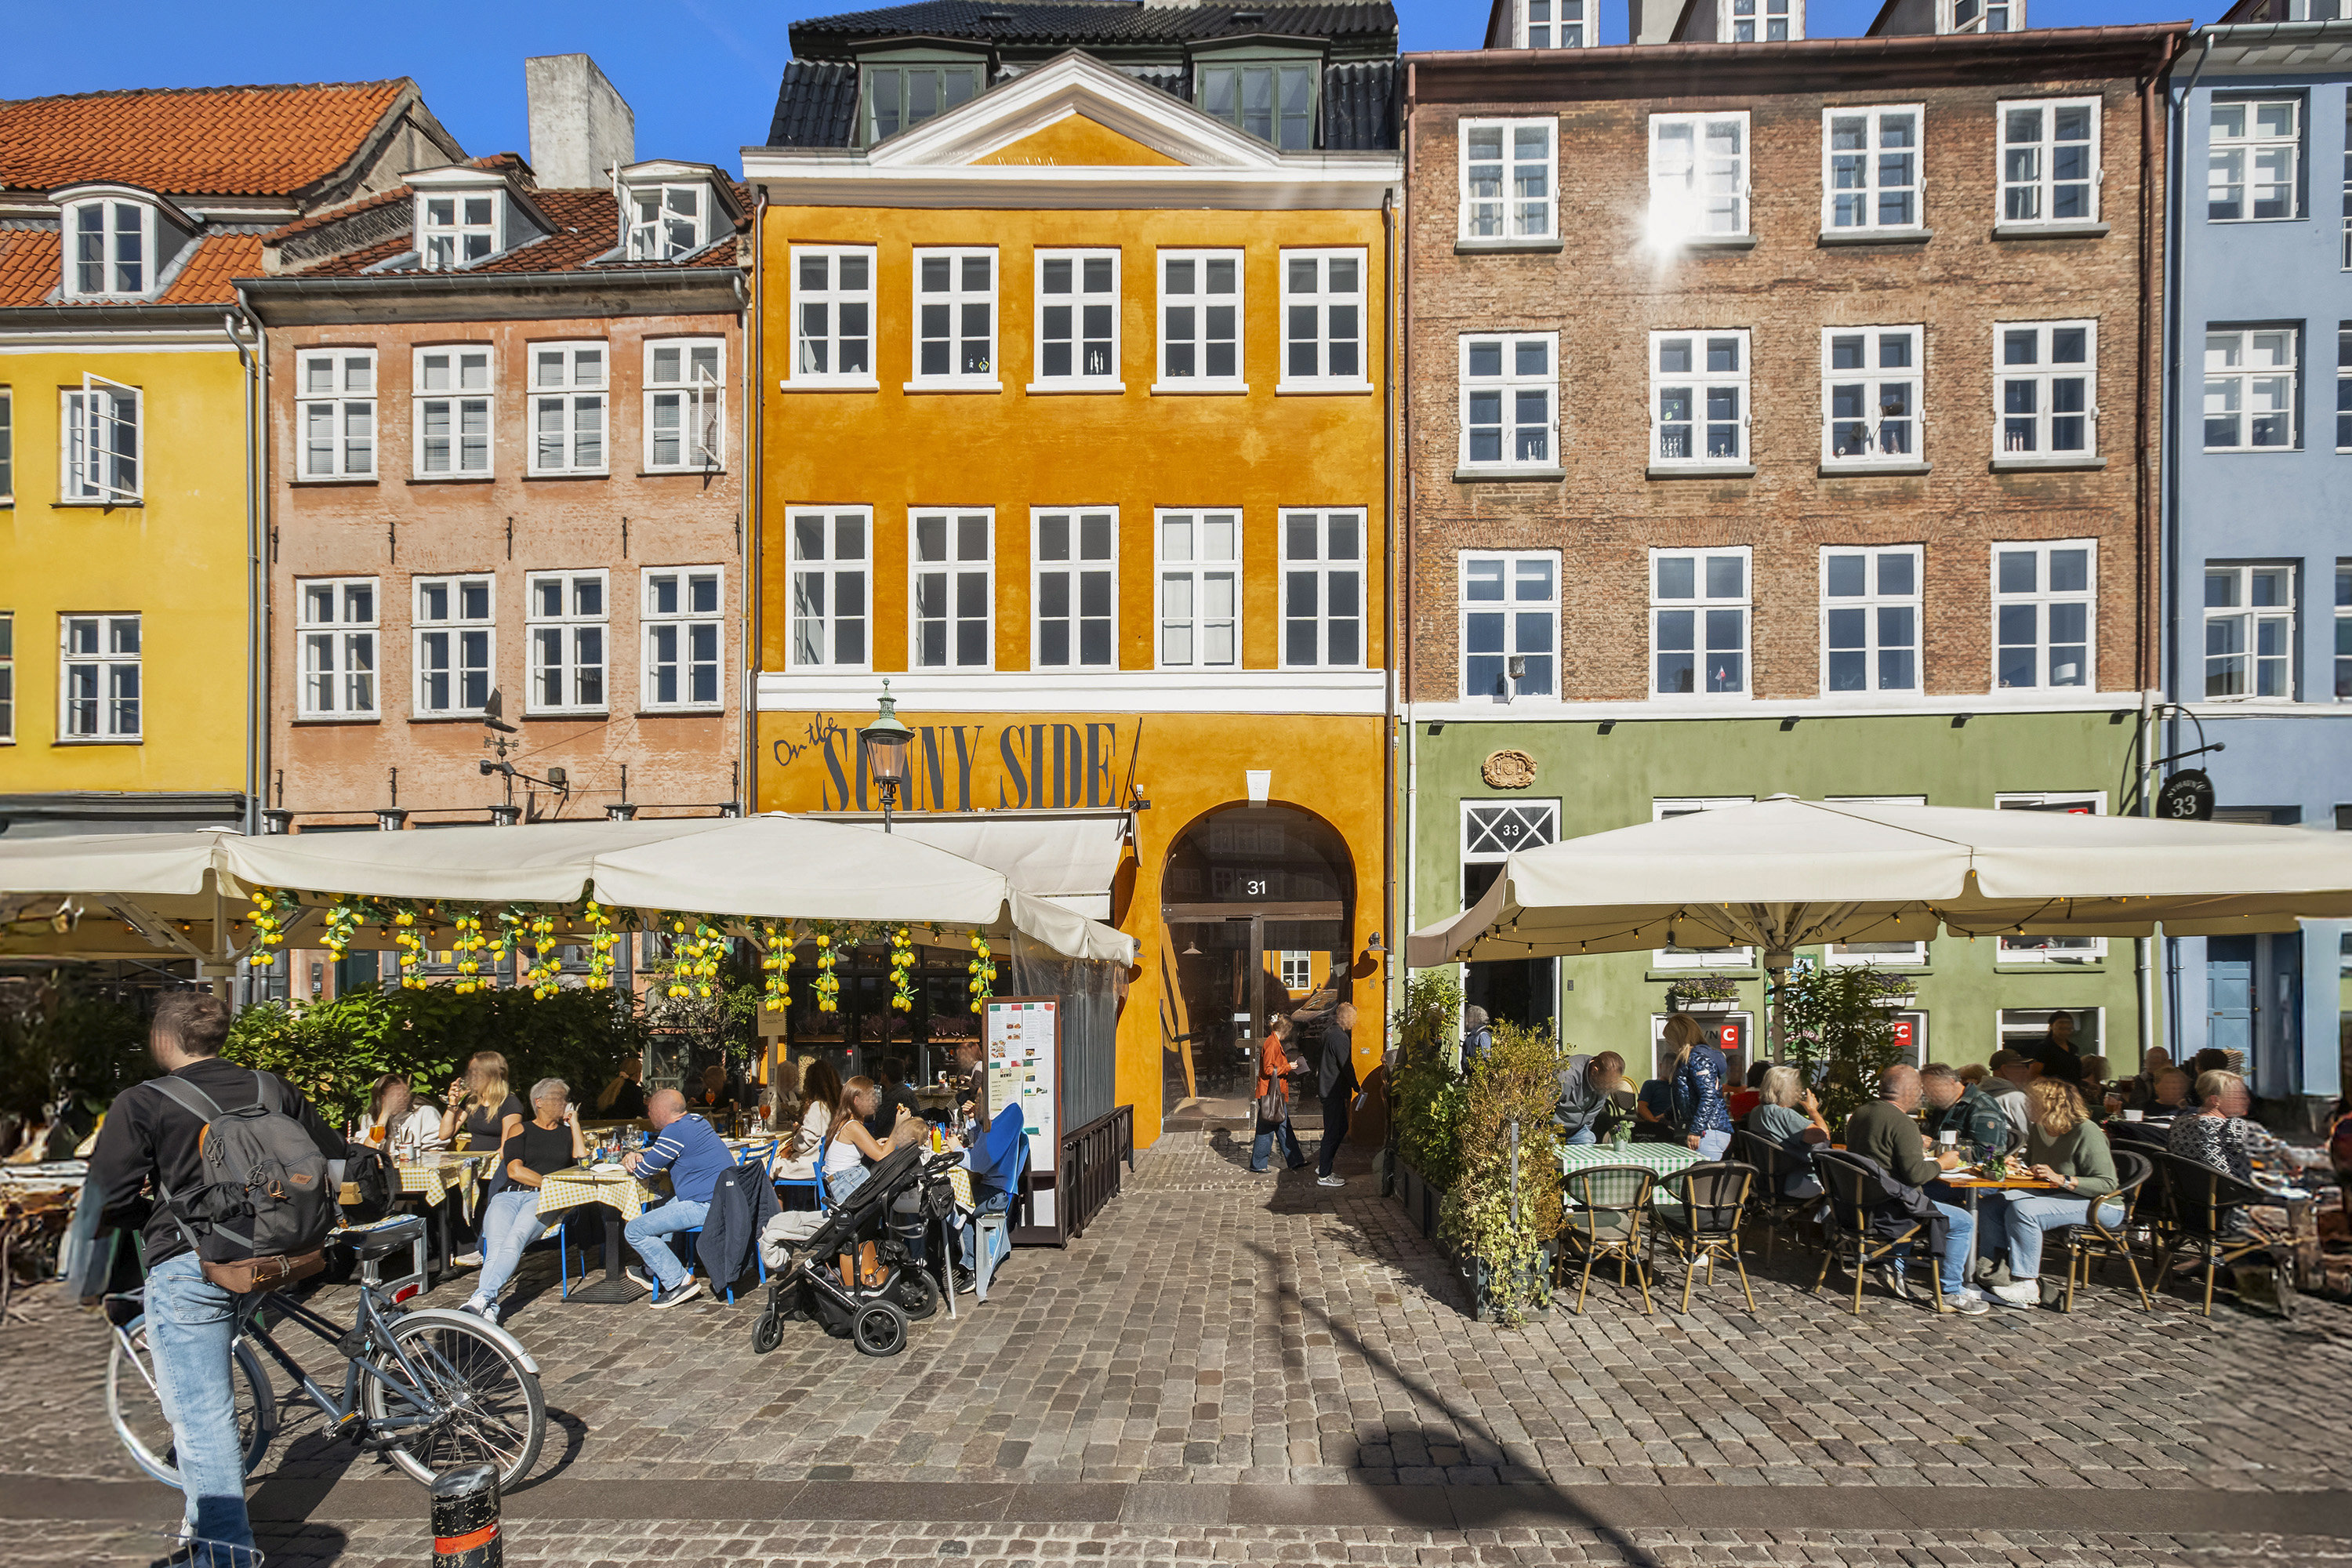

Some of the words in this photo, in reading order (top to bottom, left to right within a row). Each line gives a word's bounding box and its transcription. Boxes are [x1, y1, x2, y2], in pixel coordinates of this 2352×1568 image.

[774, 739, 808, 766] On
[804, 711, 838, 746] the
[999, 722, 1116, 810] SIDE
[2172, 794, 2198, 818] 33
[1503, 824, 1519, 837] 33
[1247, 880, 1266, 895] 31
[1722, 1028, 1736, 1041] C
